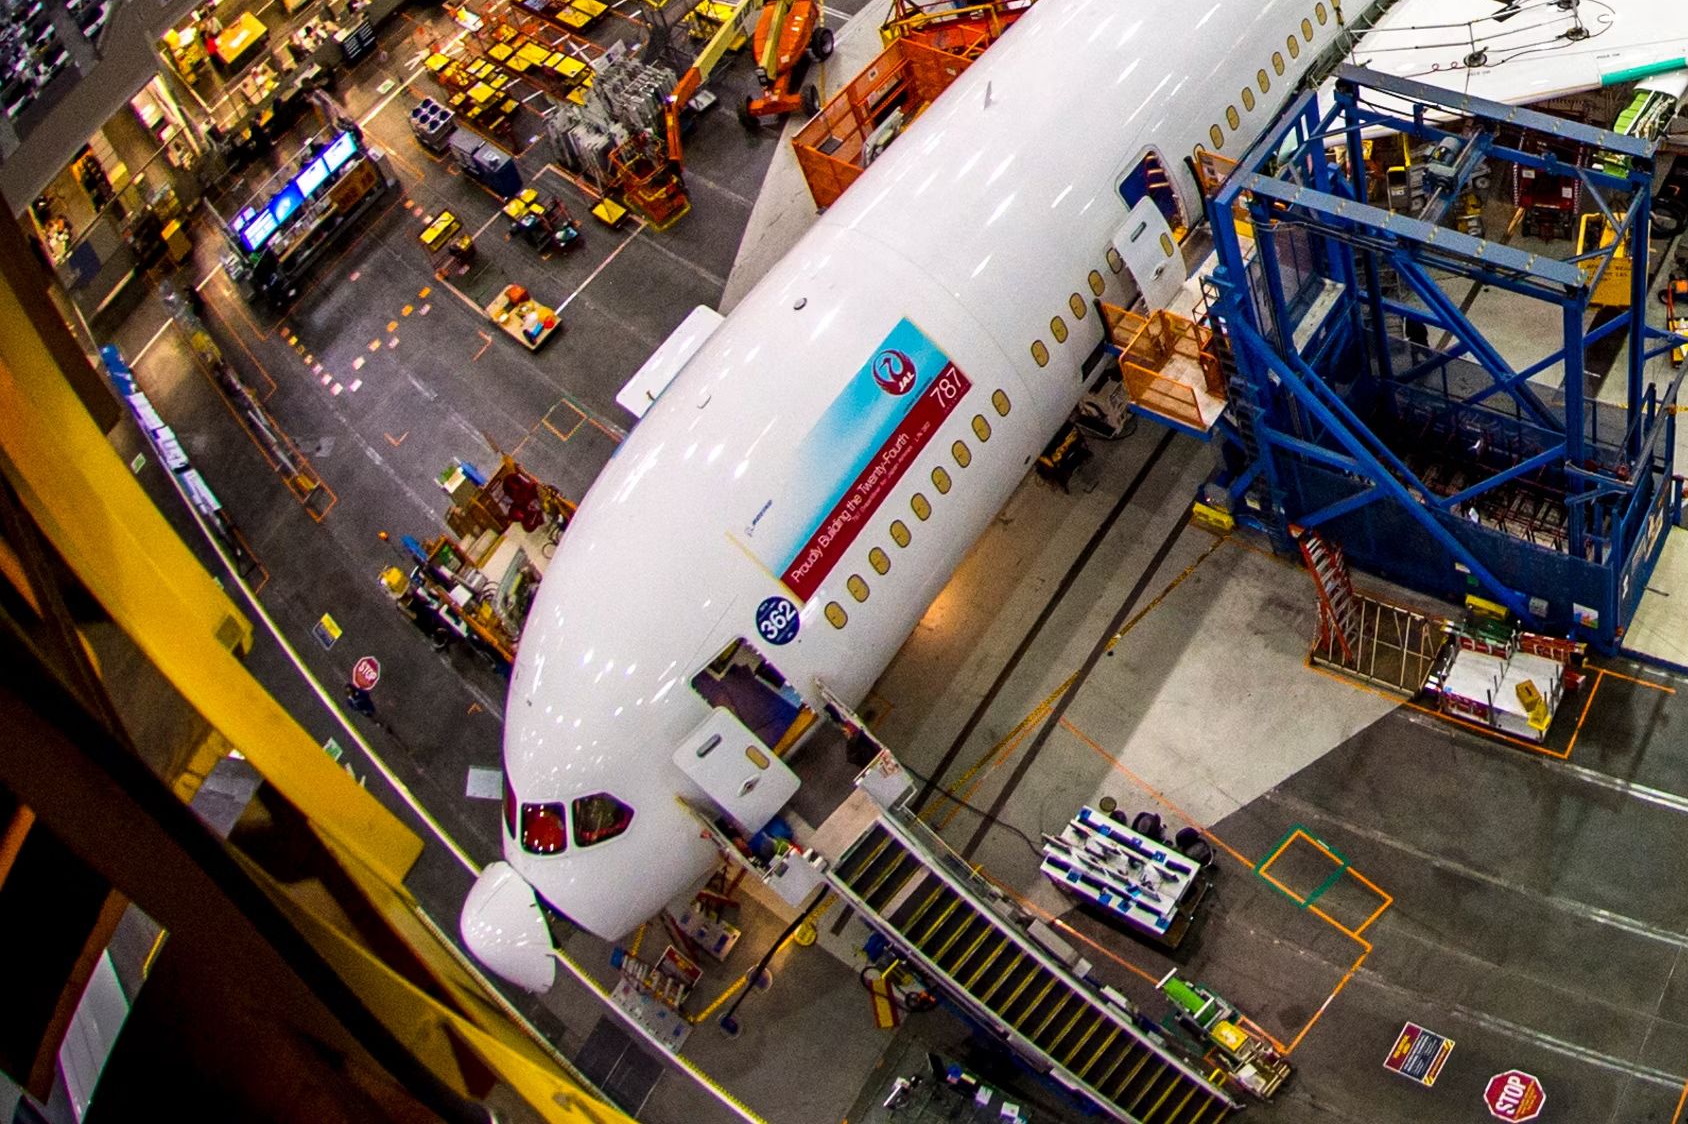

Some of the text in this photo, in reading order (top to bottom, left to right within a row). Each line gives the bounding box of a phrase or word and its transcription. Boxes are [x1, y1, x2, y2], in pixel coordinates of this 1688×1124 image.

[899, 371, 915, 392] JAL
[930, 367, 962, 408] 787
[791, 432, 910, 583] Proudly Building the Twenty-Fourth
[760, 600, 798, 640] 362
[358, 660, 378, 682] STOP
[1495, 1075, 1527, 1116] STOP
